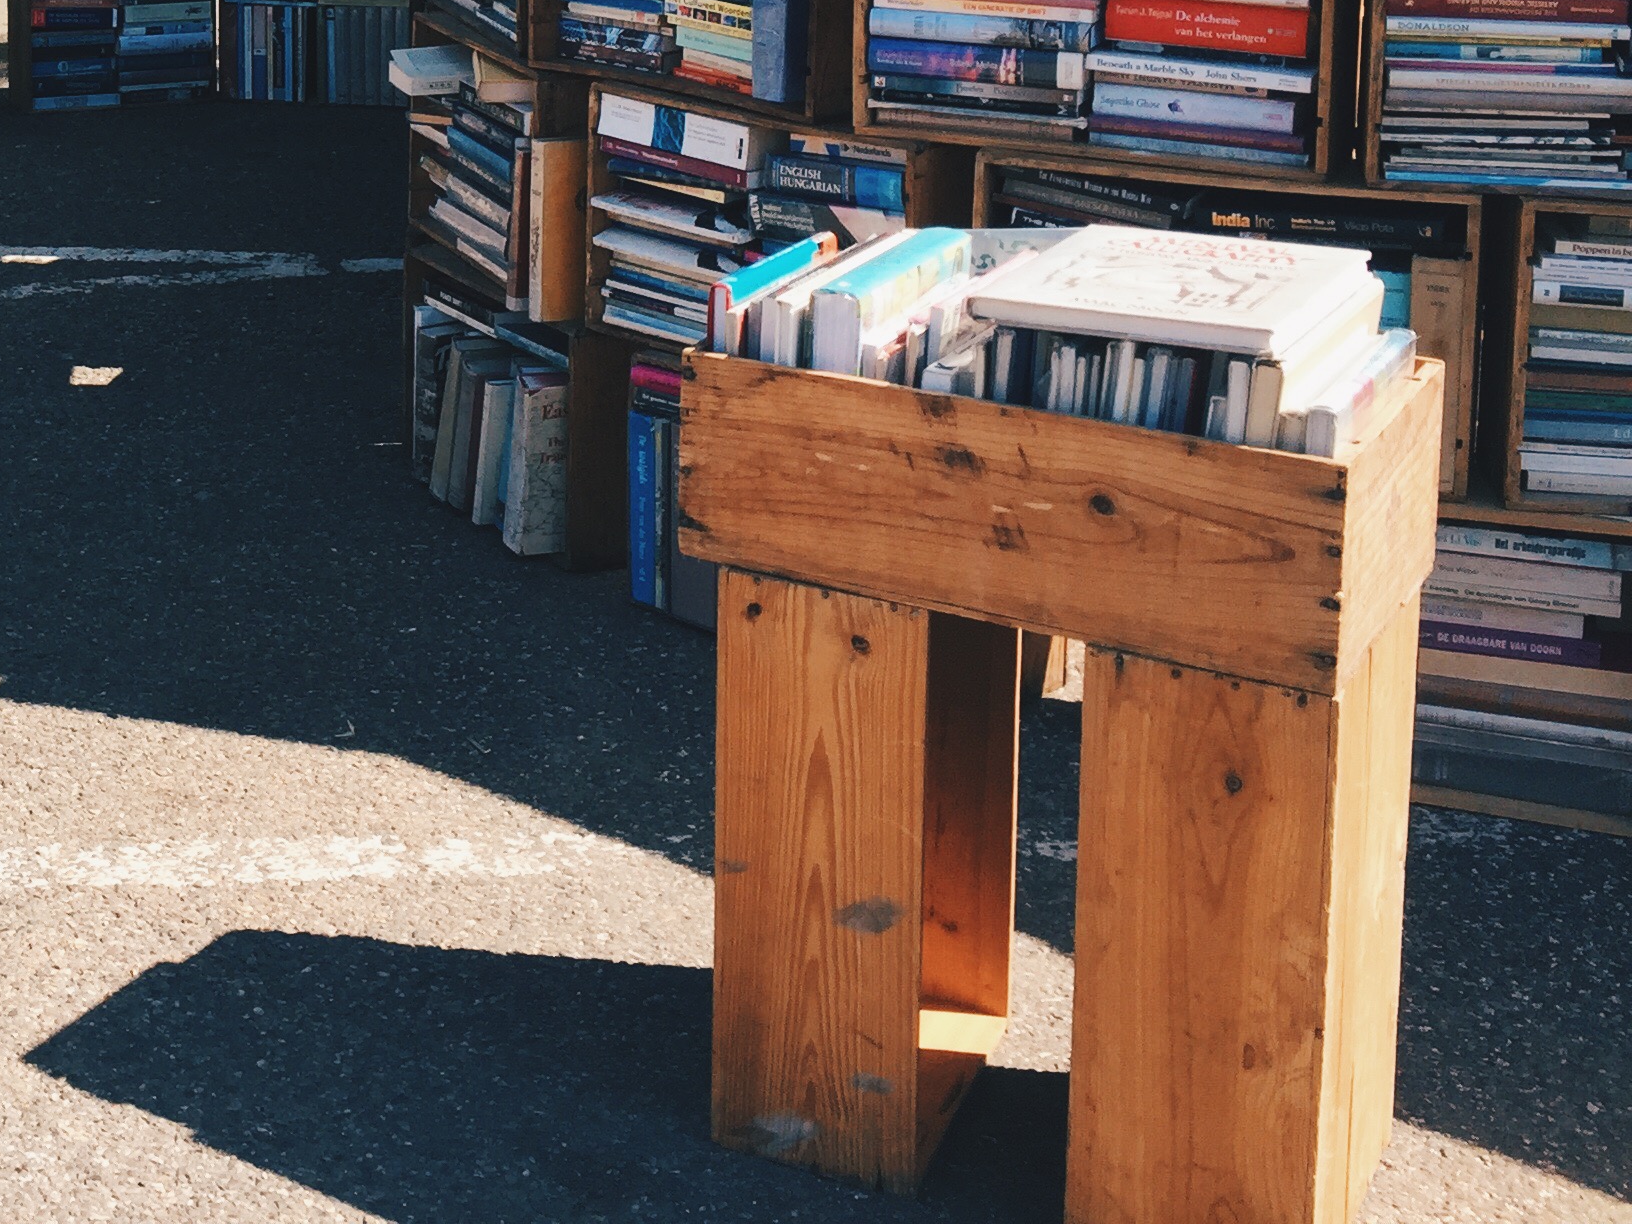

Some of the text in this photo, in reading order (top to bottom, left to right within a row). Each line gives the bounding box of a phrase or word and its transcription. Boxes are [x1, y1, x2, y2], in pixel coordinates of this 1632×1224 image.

[1175, 9, 1242, 27] De alchemie
[1174, 27, 1268, 45] van het verlangen
[1096, 58, 1134, 72] Beneath
[1178, 65, 1196, 78] Sky
[1205, 68, 1229, 81] John
[779, 165, 822, 181] ENGLISH
[779, 176, 842, 195] HUNGARIAN
[1211, 210, 1252, 228] India
[1437, 631, 1450, 643] DE
[1451, 633, 1507, 650] DRAAGBARE
[1510, 640, 1528, 652] VAN
